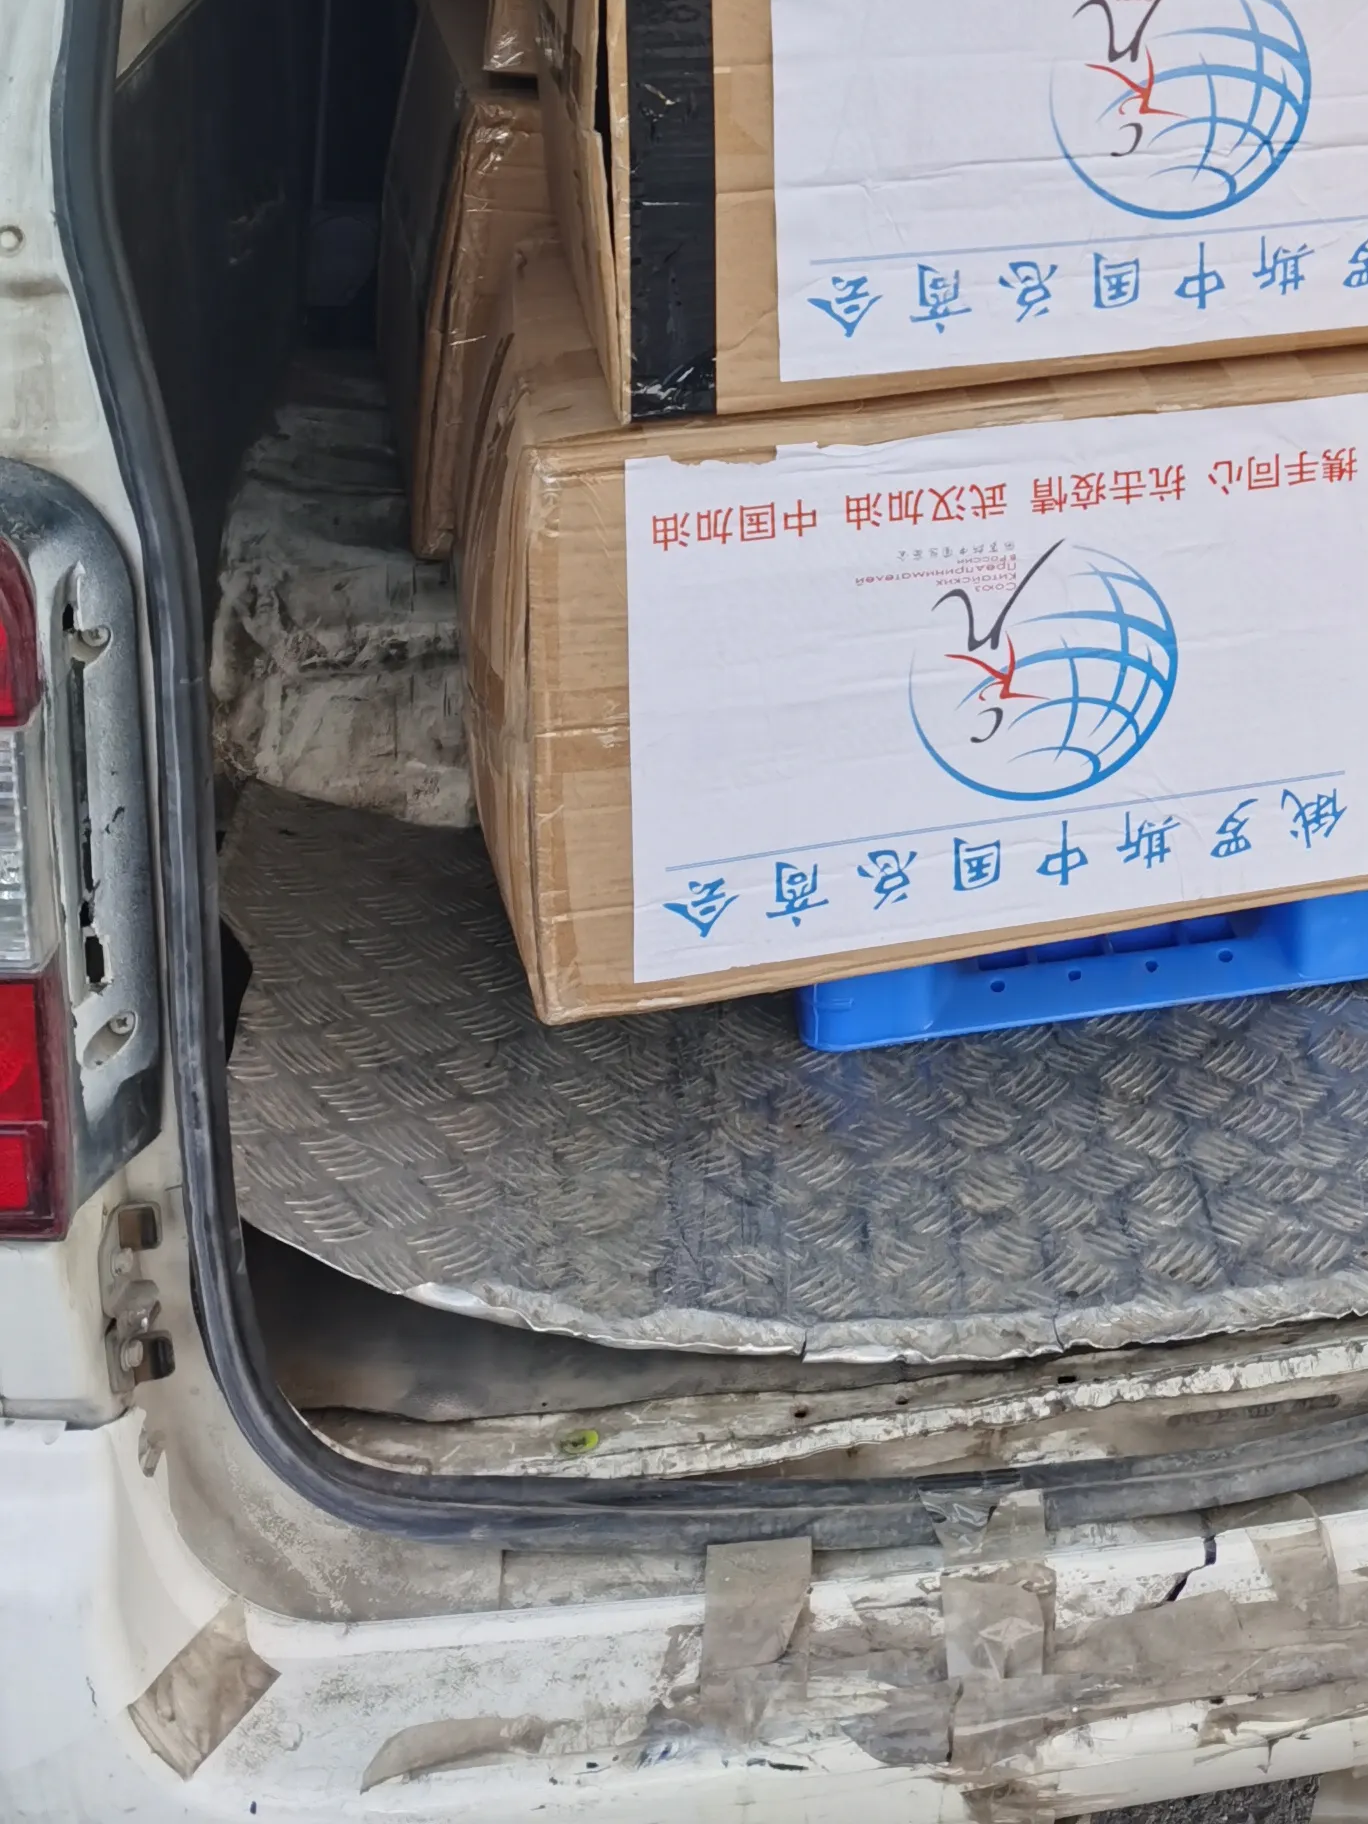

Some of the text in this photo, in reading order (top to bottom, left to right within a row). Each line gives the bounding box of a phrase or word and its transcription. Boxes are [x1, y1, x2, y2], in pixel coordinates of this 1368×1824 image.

[651, 447, 1357, 551] 携手同心 抗击疫情 武汉加油 中国加油
[975, 582, 1016, 592] Союз
[663, 787, 1346, 940] 俄罗斯中国总商会
